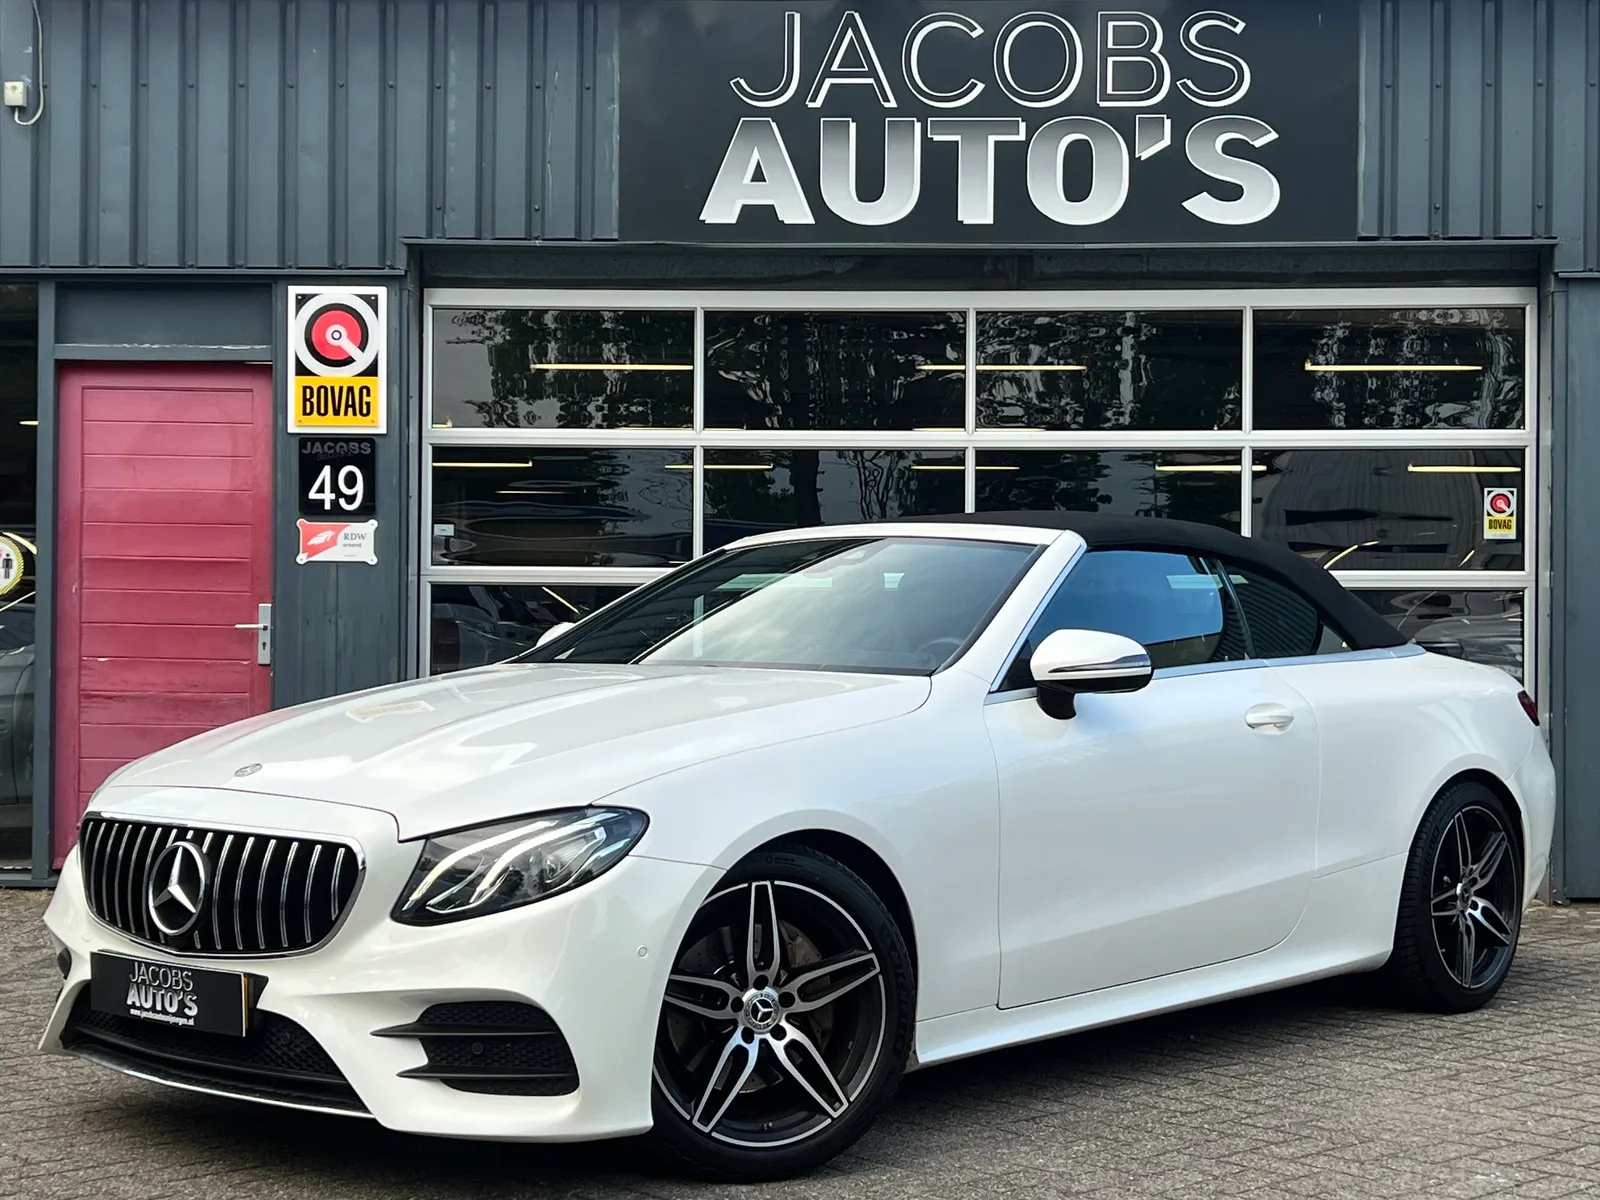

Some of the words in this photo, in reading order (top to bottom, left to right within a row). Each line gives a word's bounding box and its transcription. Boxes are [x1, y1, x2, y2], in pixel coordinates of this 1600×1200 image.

[729, 10, 1252, 108] JACOBS
[698, 114, 1281, 226] AUTO'S
[302, 385, 371, 417] BOVAG
[301, 441, 371, 455] JACOBS
[308, 465, 364, 511] 49
[344, 532, 367, 541] RDW
[1488, 519, 1512, 530] BOVAG
[128, 961, 194, 992] JACOBS
[126, 982, 199, 1017] AUTO'S
